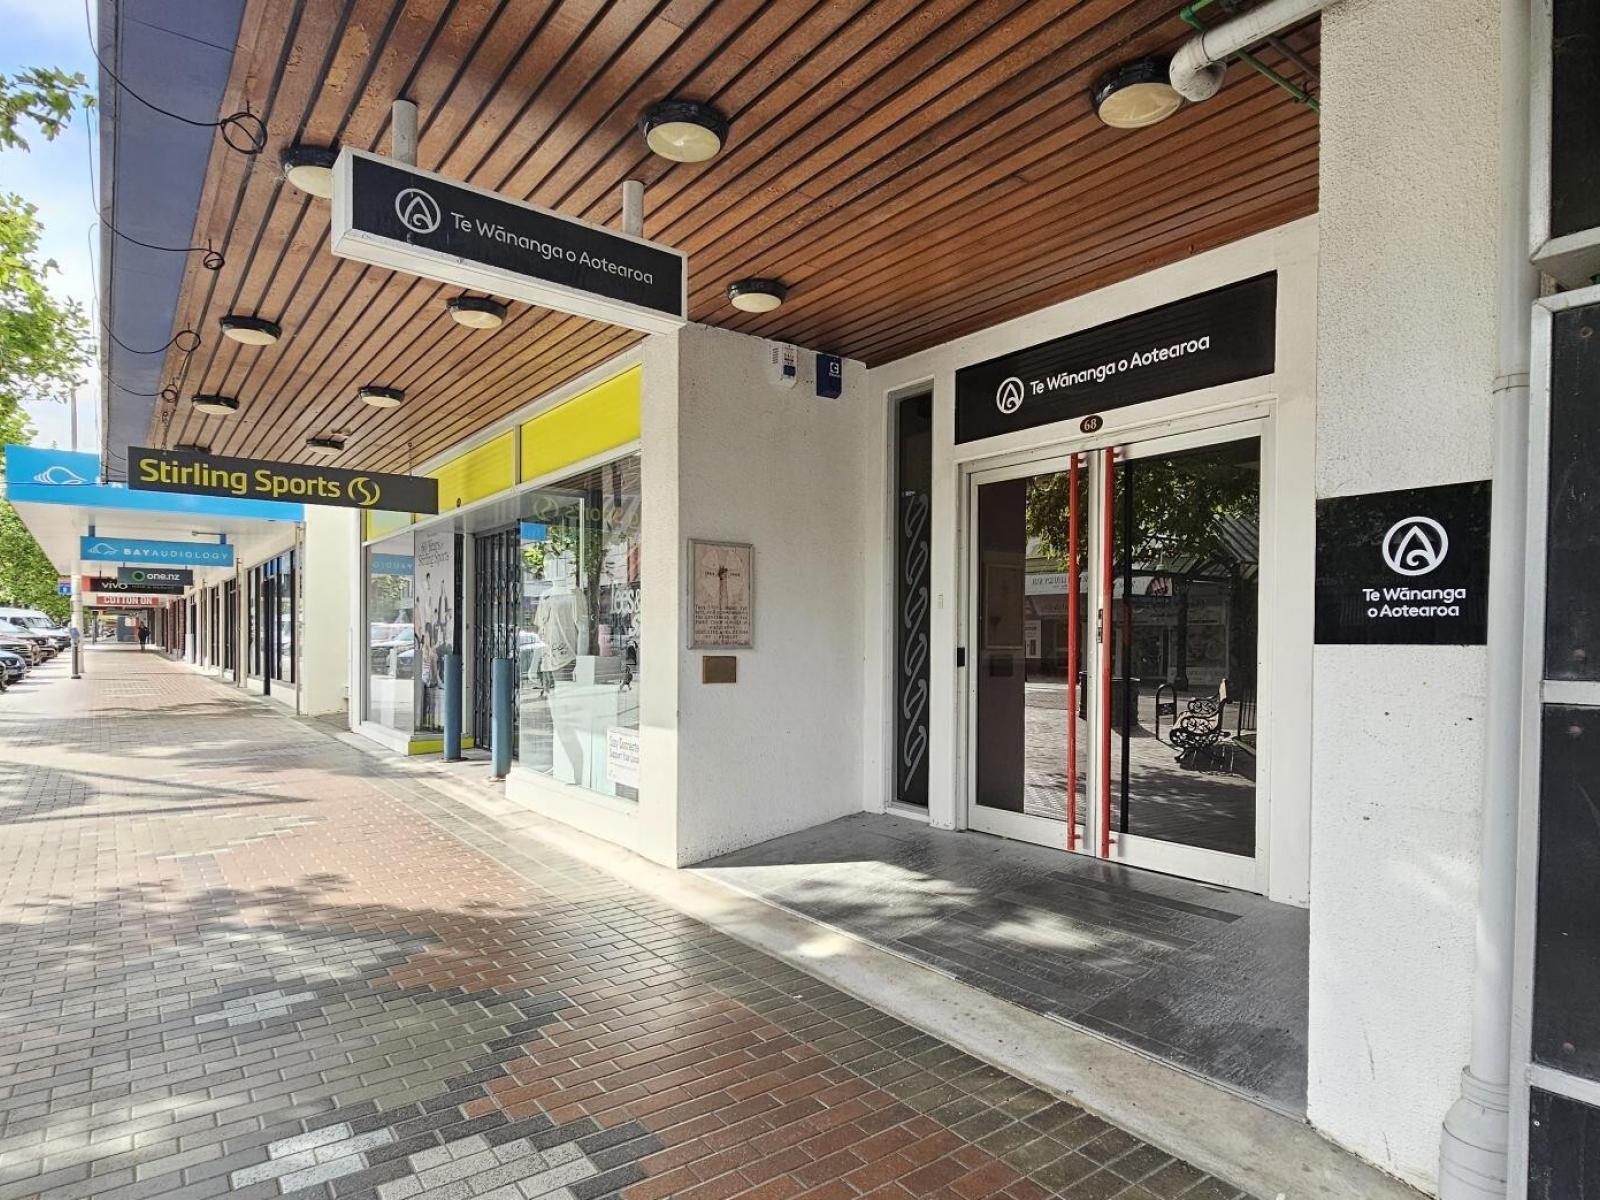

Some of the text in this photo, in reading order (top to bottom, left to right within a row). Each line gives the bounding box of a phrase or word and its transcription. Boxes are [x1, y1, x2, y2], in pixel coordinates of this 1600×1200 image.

[451, 212, 653, 285] Te Wānanga o Aotearoa
[1030, 335, 1210, 395] Te Wānanga o Aotearoa
[1083, 418, 1098, 431] 68
[139, 459, 341, 498] Stirling Sports
[146, 572, 180, 581] one.nz
[101, 579, 128, 590] vivo
[103, 597, 153, 606] COTTON ON
[1362, 587, 1466, 604] Te Wānanga
[1367, 603, 1460, 618] o Aotearoa
